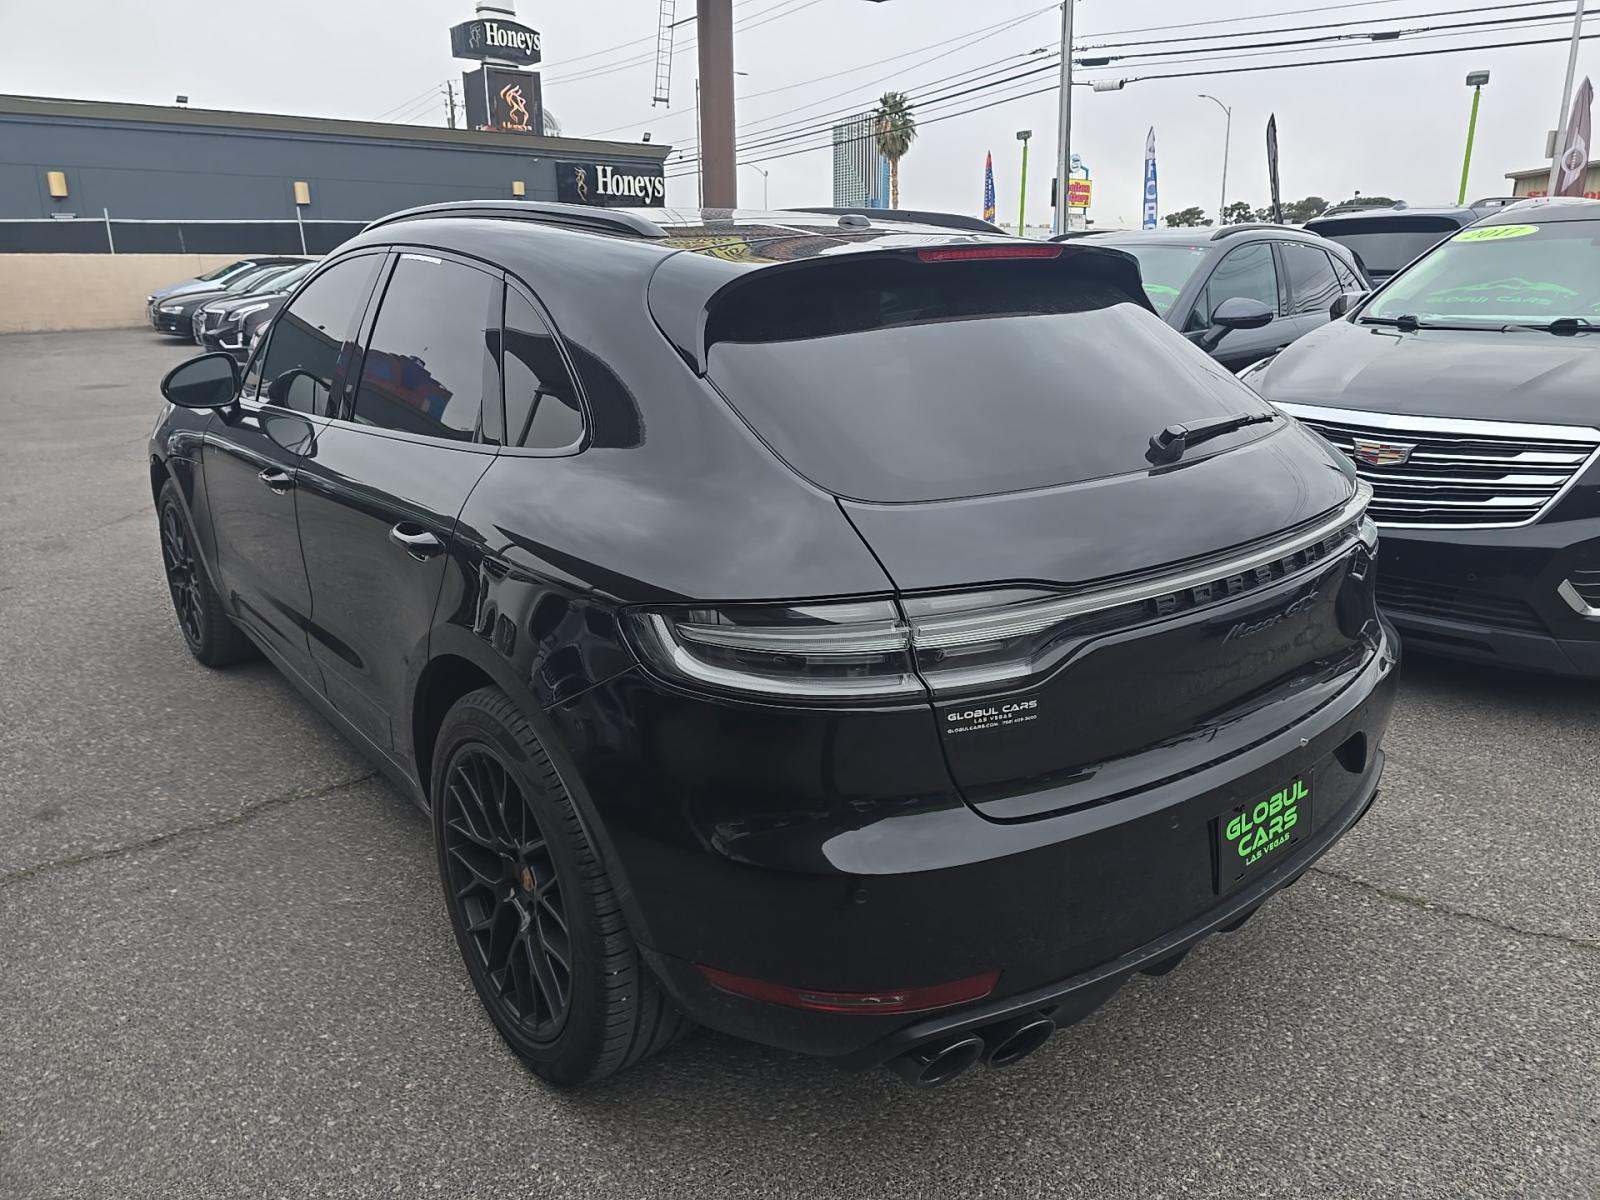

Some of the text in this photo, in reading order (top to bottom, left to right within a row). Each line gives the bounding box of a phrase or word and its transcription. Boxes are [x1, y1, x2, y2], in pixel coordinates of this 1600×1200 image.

[484, 22, 540, 55] Honeys
[595, 165, 664, 204] Honeys
[1144, 159, 1157, 229] FOR
[947, 700, 1037, 722] GLOBUL CARS
[990, 713, 1013, 721] VEGAS
[1226, 780, 1309, 841] GLOBUL
[1238, 805, 1298, 856] CARS
[1246, 832, 1290, 866] LAS VEGAS
